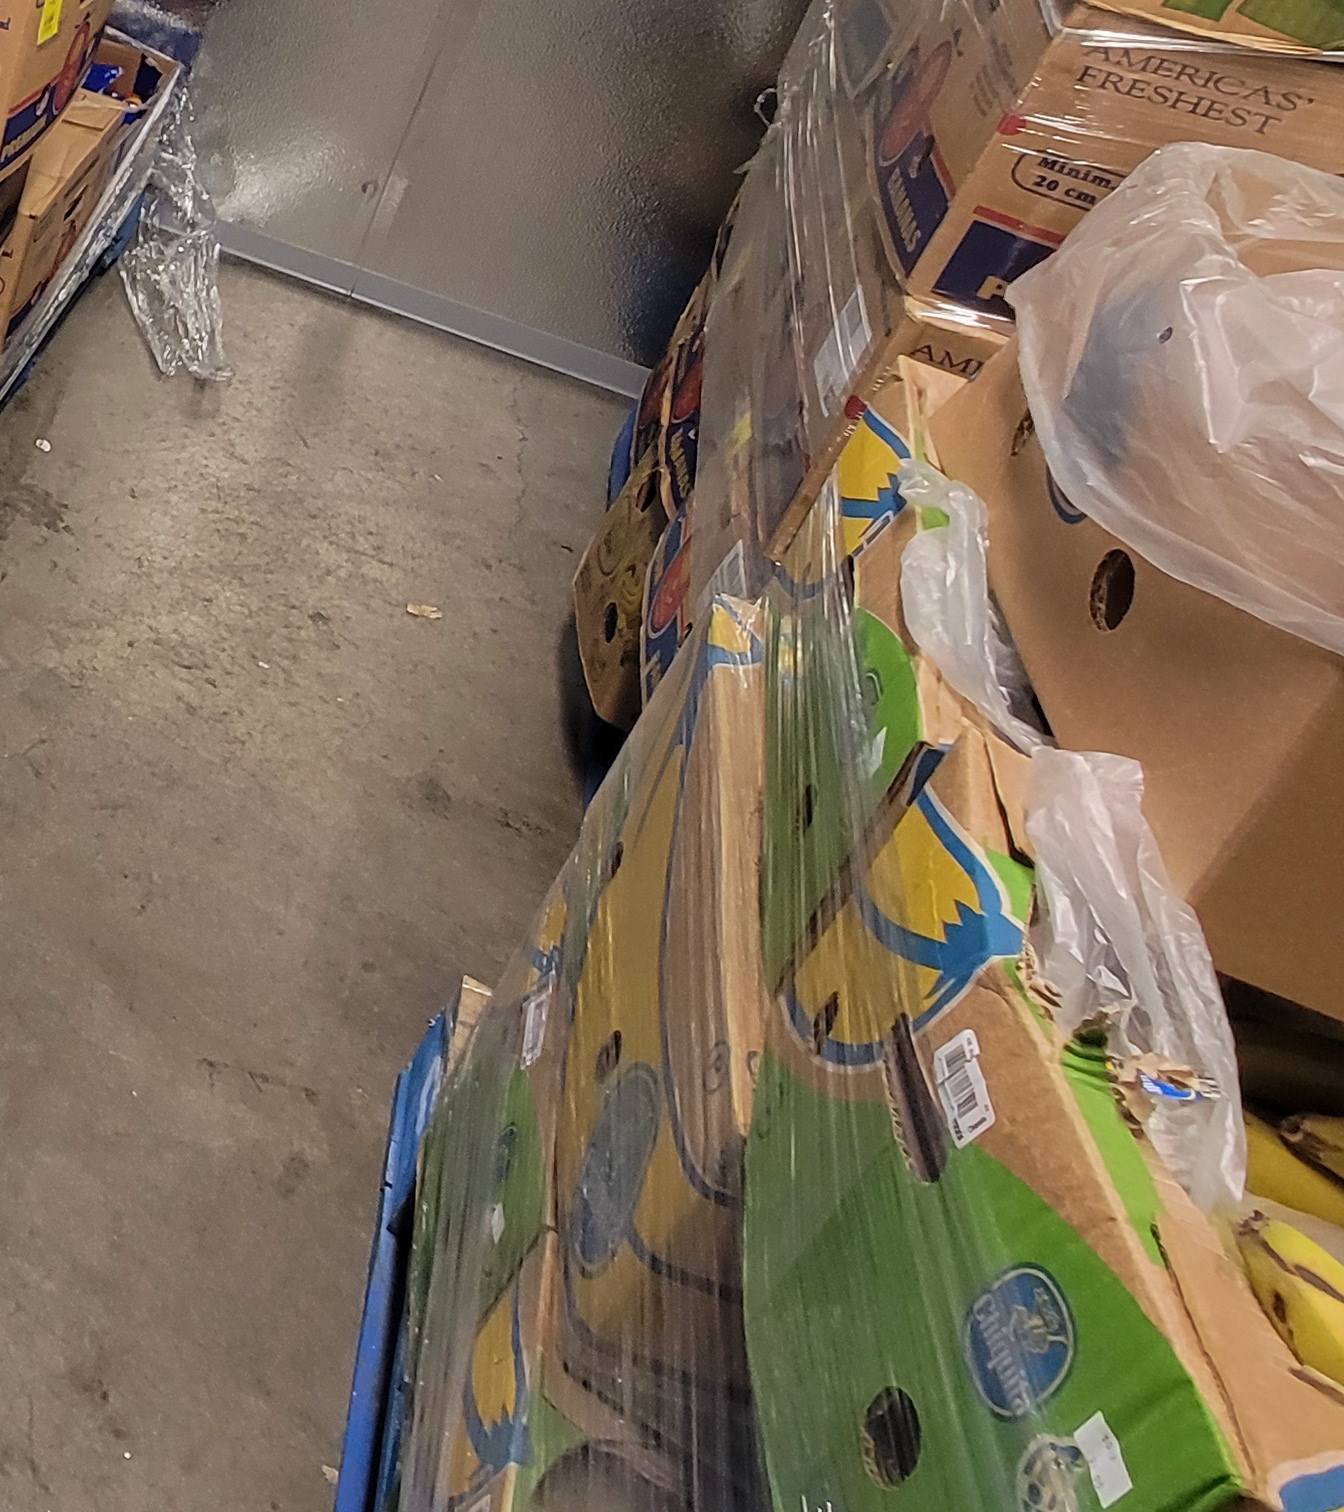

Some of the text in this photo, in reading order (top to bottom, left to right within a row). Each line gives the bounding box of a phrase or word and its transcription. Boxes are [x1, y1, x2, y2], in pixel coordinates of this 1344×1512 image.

[1075, 65, 1283, 136] FRESHEST
[1031, 174, 1099, 206] 20 cm
[1038, 155, 1114, 190] Minim
